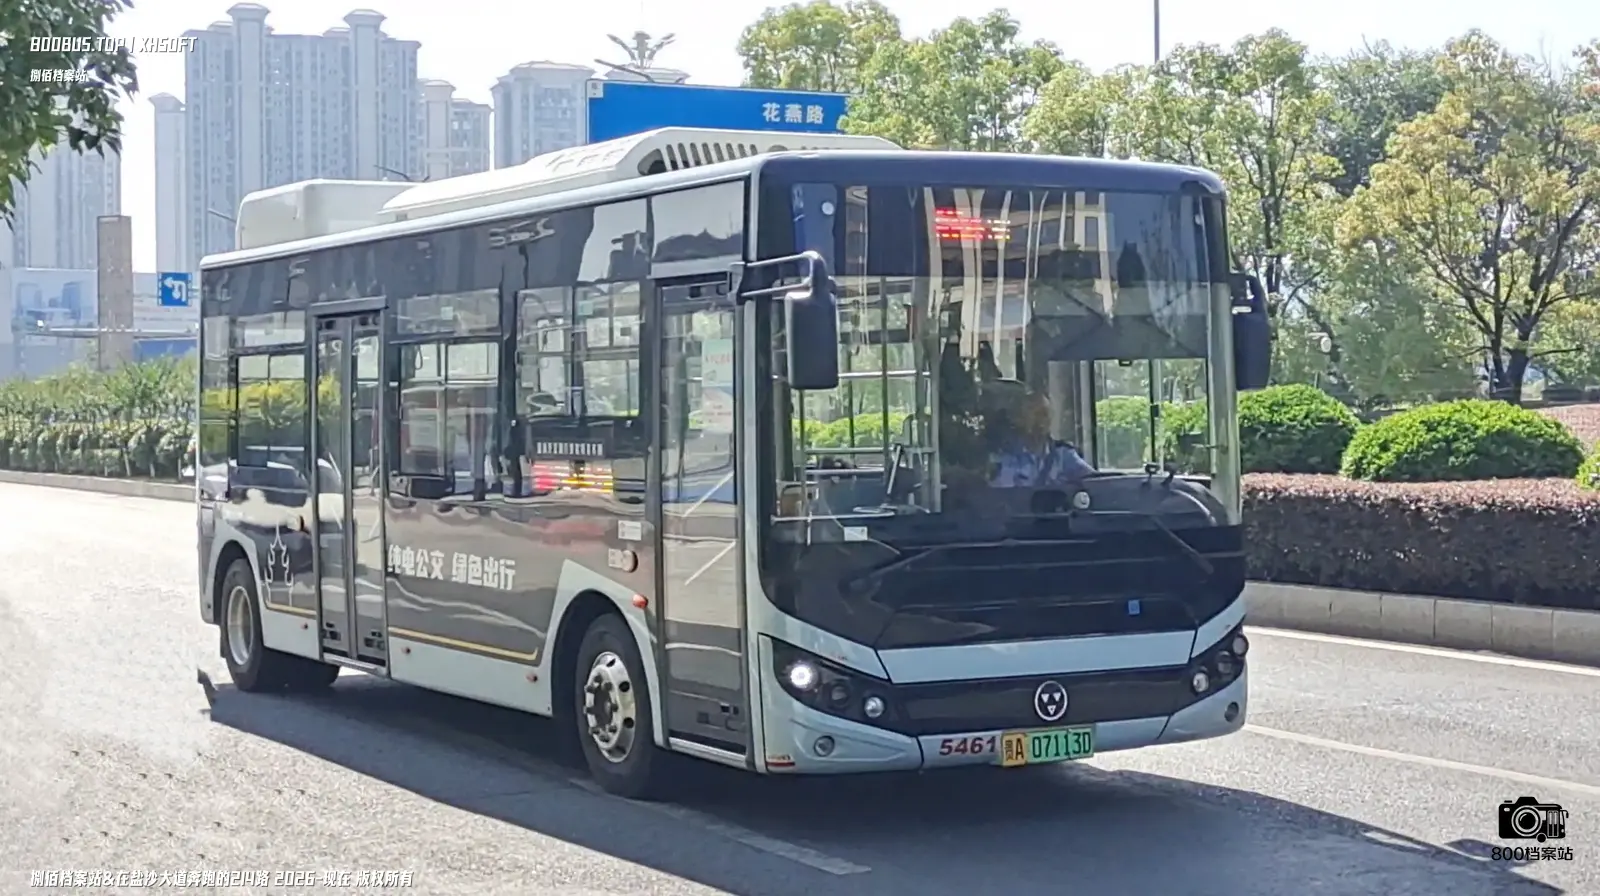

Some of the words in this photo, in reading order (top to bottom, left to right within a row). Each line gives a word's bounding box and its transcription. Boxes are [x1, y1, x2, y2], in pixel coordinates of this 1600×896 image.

[762, 102, 824, 125] 花燕路
[387, 544, 445, 580] 纯电公交
[452, 551, 516, 591] 绿色出行
[939, 736, 997, 757] 5461
